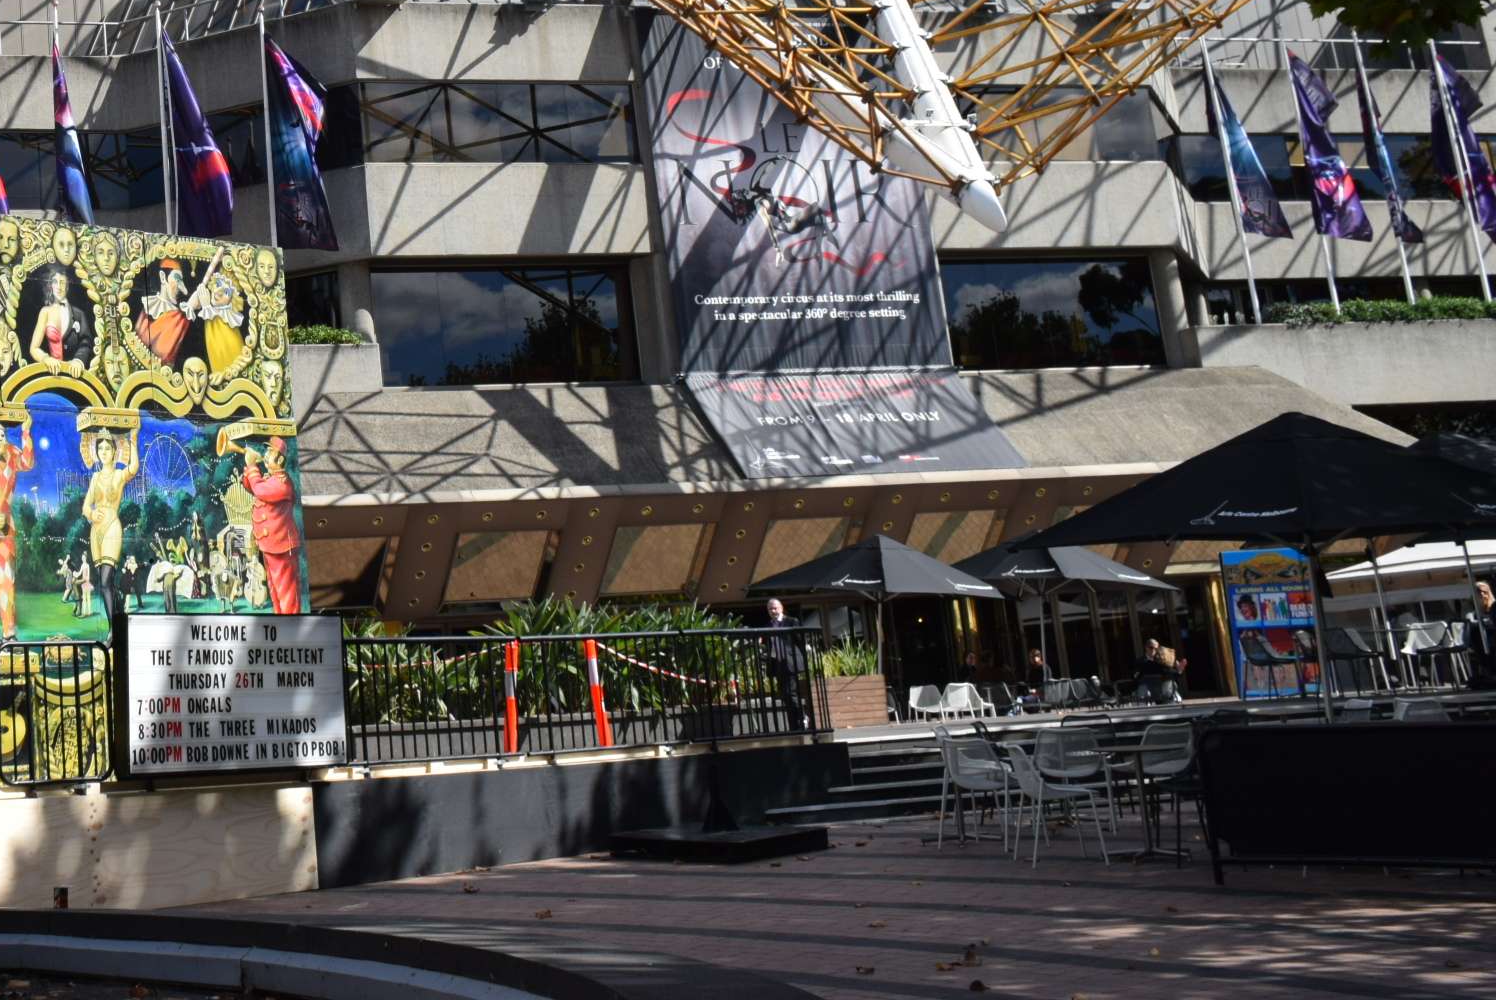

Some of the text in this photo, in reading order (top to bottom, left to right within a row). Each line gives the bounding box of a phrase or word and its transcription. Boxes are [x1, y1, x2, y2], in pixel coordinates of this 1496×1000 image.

[760, 122, 801, 153] LE
[694, 290, 920, 307] Contemporary circus at its most thrilling
[714, 310, 726, 320] in
[728, 312, 736, 320] a
[738, 309, 803, 323] spectacular
[829, 308, 866, 321] degree
[869, 306, 906, 319] setting
[757, 415, 803, 426] FROM
[808, 415, 815, 424] 9
[859, 412, 898, 423] APRIL
[901, 411, 940, 421] ONLY
[191, 625, 277, 641] WELCOME TO
[151, 648, 324, 665] THE FAMOUS SPIEGELTENT
[169, 672, 314, 689] THURSDAY 26TH MARCH
[138, 697, 232, 715] 7:00PM ONGALS
[138, 718, 317, 739] 8:30PM THE THREE MIKADOS
[133, 747, 182, 765] 10:00PM
[186, 746, 208, 762] BOB
[212, 743, 250, 761] DOWNE
[256, 743, 267, 759] IN
